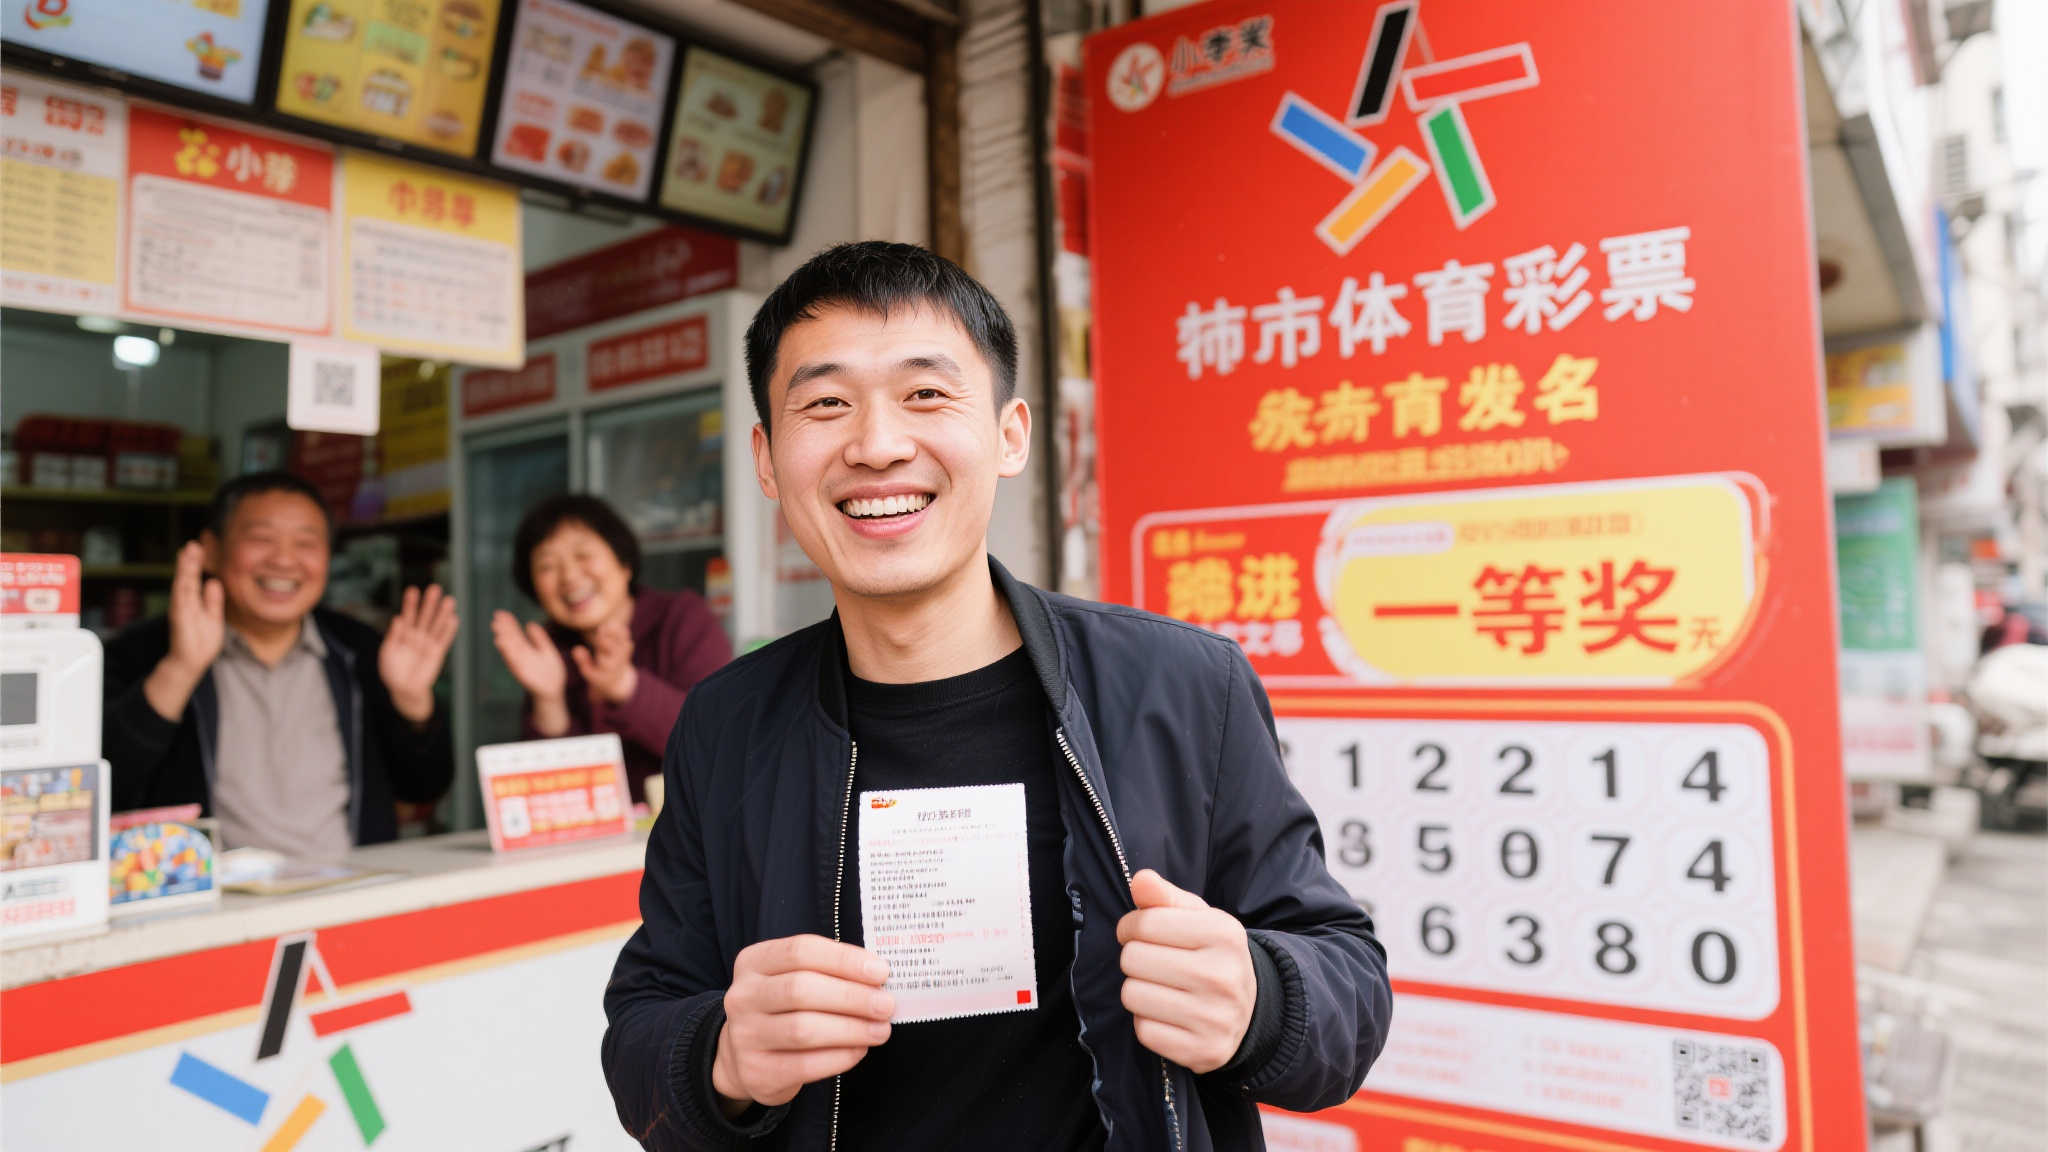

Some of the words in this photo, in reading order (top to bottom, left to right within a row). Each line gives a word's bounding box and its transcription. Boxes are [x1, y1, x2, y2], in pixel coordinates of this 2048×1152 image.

[1372, 559, 1679, 656] 一等奖
[1339, 742, 1361, 790] 1
[1412, 743, 1450, 793] 2
[1497, 745, 1536, 797] 2
[1590, 748, 1618, 800] 1
[1679, 749, 1728, 803] 4
[1416, 824, 1454, 875] 5
[1499, 829, 1541, 881] 0
[1589, 833, 1631, 887] 7
[1685, 839, 1732, 894] 4
[1418, 905, 1458, 957] 6
[1504, 913, 1545, 967] 3
[1593, 920, 1639, 977] 8
[1690, 929, 1739, 987] 0
